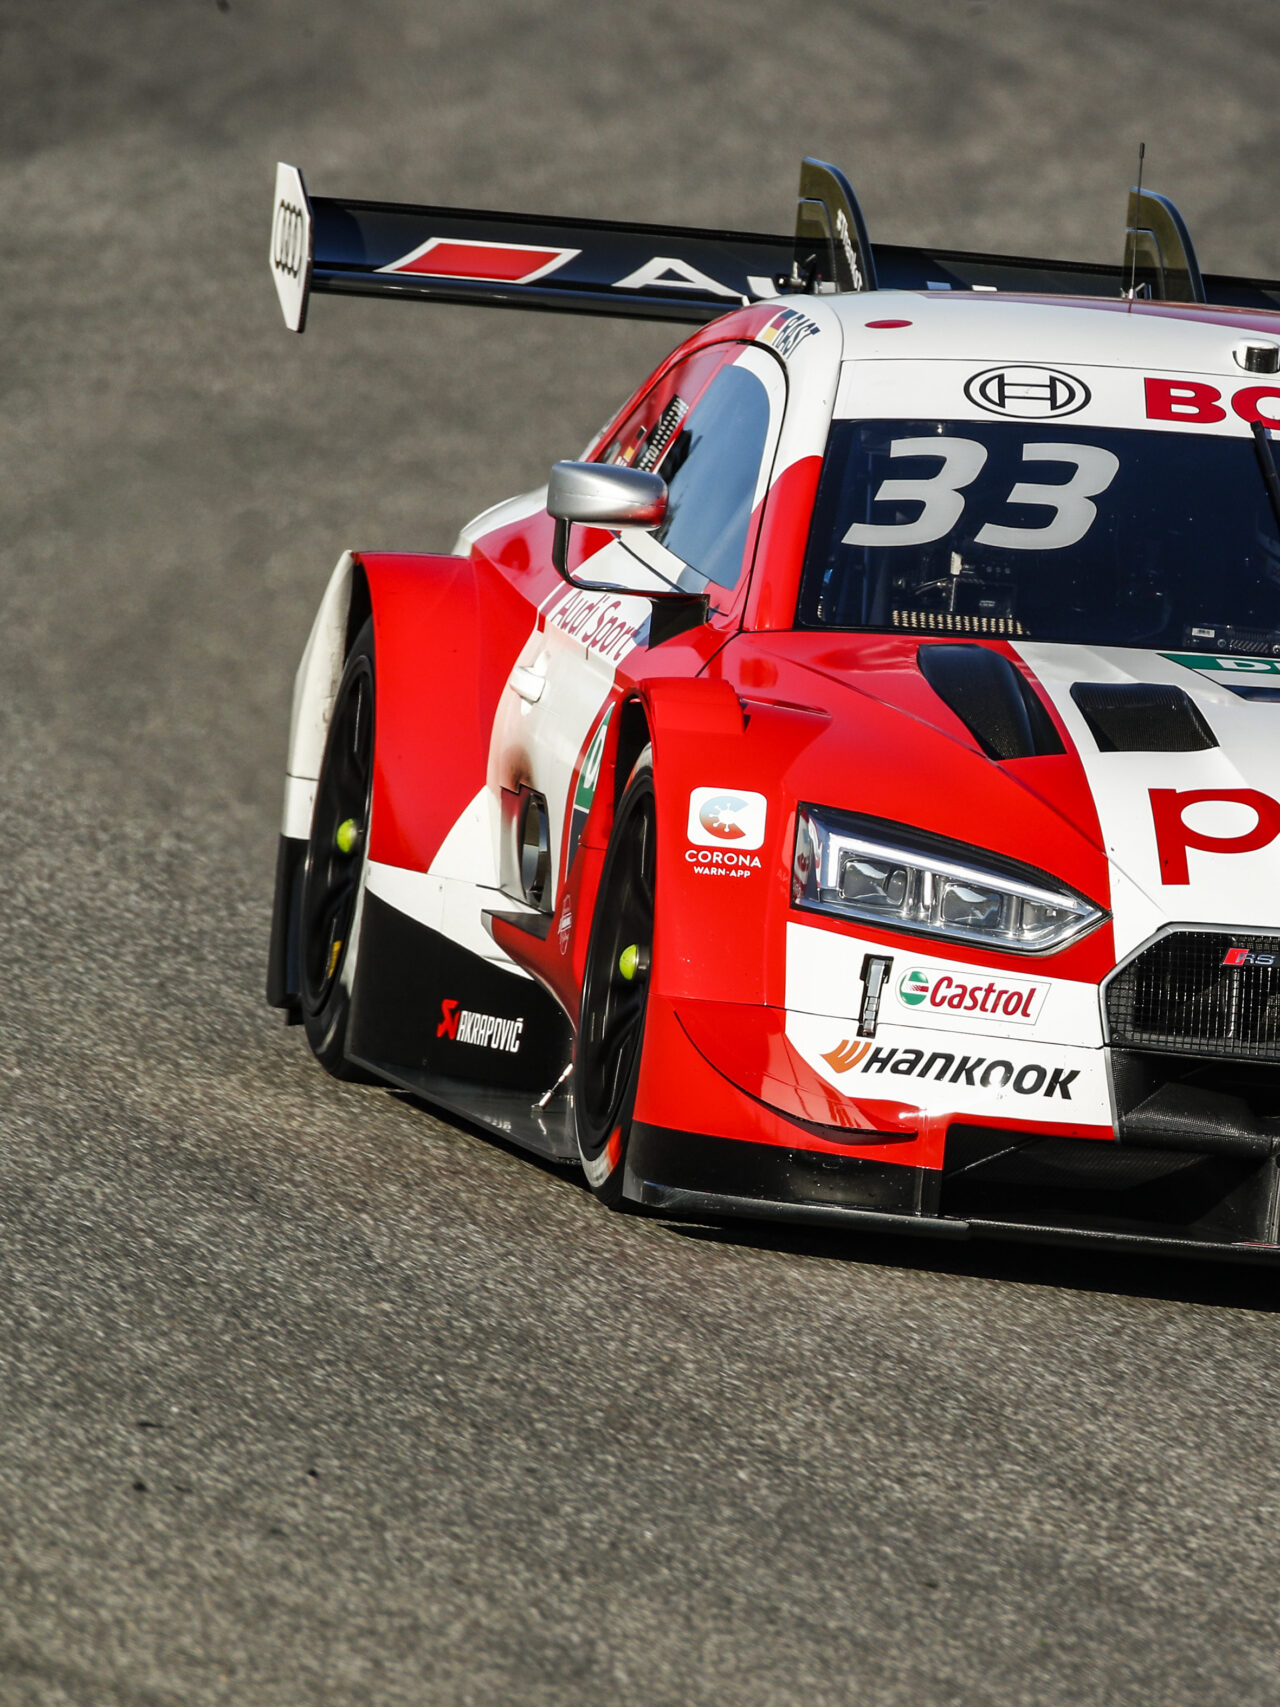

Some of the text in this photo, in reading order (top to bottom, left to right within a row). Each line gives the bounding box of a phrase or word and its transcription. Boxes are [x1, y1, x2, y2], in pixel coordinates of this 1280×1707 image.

[840, 435, 1120, 550] 33
[551, 590, 639, 661] Audi Sport
[685, 850, 762, 868] CORONA
[693, 865, 751, 878] WARN-APP
[1235, 952, 1275, 965] RS
[930, 976, 1037, 1018] Castrol
